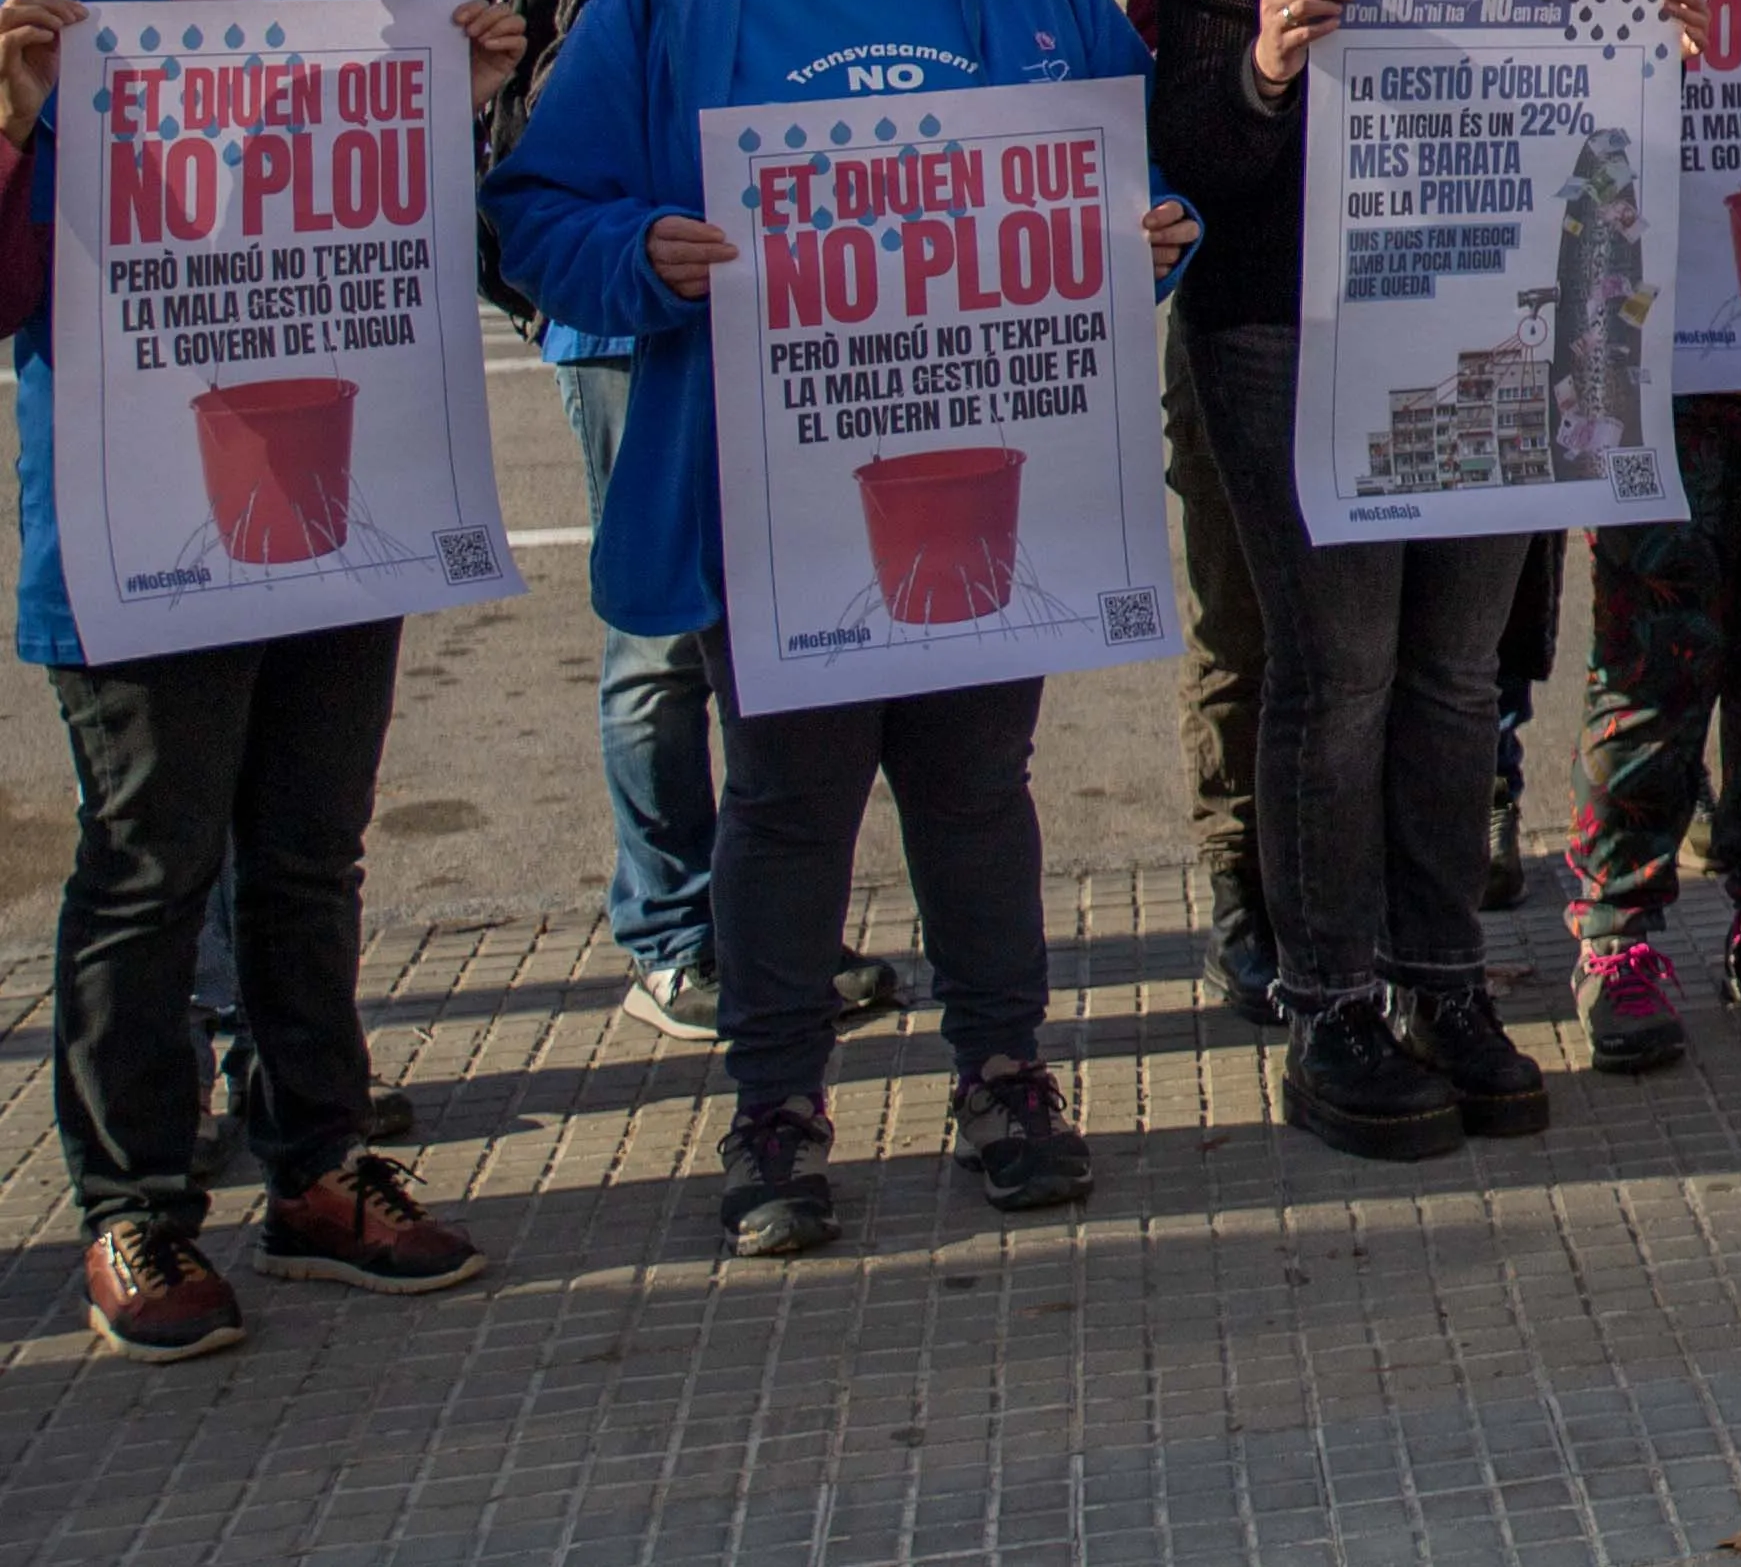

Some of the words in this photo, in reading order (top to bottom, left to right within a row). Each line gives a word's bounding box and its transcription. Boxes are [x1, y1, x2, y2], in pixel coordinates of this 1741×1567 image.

[1345, 3, 1379, 25] D'on
[1413, 0, 1441, 22] n'hi
[1446, 2, 1464, 22] ha
[1512, 4, 1530, 22] en
[1534, 3, 1562, 25] raja
[110, 69, 162, 134] ET
[184, 64, 322, 128] DIUEN
[338, 61, 424, 121] QUE
[848, 64, 924, 91] NO
[1350, 75, 1373, 102] LA
[1380, 59, 1472, 100] GESTIÓ
[1481, 58, 1590, 99] PÚBLICA
[1349, 116, 1374, 140] DE
[1379, 113, 1453, 139] L'AIGUA
[1459, 107, 1482, 137] ÉS
[1488, 111, 1514, 137] UN
[1519, 103, 1594, 137] 22%
[1349, 137, 1409, 179] MÉS
[1418, 141, 1520, 177] BARATA
[1680, 144, 1708, 173] EL
[109, 140, 216, 244] NO
[242, 128, 426, 235] PLOU
[759, 164, 819, 227] ET
[834, 149, 984, 217] DIUEN
[1002, 140, 1099, 208] QUE
[1348, 191, 1385, 220] QUE
[1389, 189, 1413, 216] LA
[1420, 178, 1534, 215] PRIVADA
[1349, 230, 1378, 252] UNS
[1383, 228, 1423, 250] POCS
[1426, 228, 1456, 249] FAN
[1460, 226, 1516, 247] NEGOCI
[1349, 253, 1384, 273] AMB
[1388, 253, 1408, 272] LA
[1412, 250, 1452, 271] POCA
[1456, 249, 1502, 270] AIGUA
[110, 249, 178, 294] PERÒ
[187, 244, 262, 288] NINGÚ
[271, 248, 305, 280] NO
[313, 239, 429, 278] T'EXPLICA
[765, 224, 878, 331] NO
[903, 204, 1104, 317] PLOU
[1348, 277, 1376, 298] QUE
[1379, 274, 1432, 297] QUEDA
[121, 297, 155, 331] LA
[163, 291, 240, 327] MALA
[248, 280, 332, 321] GESTIÓ
[340, 281, 388, 312] QUE
[394, 277, 422, 309] FA
[136, 337, 167, 370] EL
[175, 328, 275, 366] GOVERN
[284, 324, 315, 358] DE
[323, 314, 415, 352] L'AIGUA
[770, 333, 840, 375] PERÒ
[849, 325, 928, 366] NINGÚ
[937, 324, 973, 359] NO
[980, 312, 1106, 358] T'EXPLICA
[783, 375, 817, 409] LA
[825, 368, 905, 403] MALA
[912, 353, 1001, 396] GESTIÓ
[1009, 354, 1059, 389] QUE
[1066, 348, 1098, 382] FA
[798, 410, 830, 444] EL
[836, 401, 941, 441] GOVERN
[949, 398, 983, 429] DE
[989, 384, 1087, 425] L'AIGUA
[786, 624, 872, 653] #NoEnRaja
